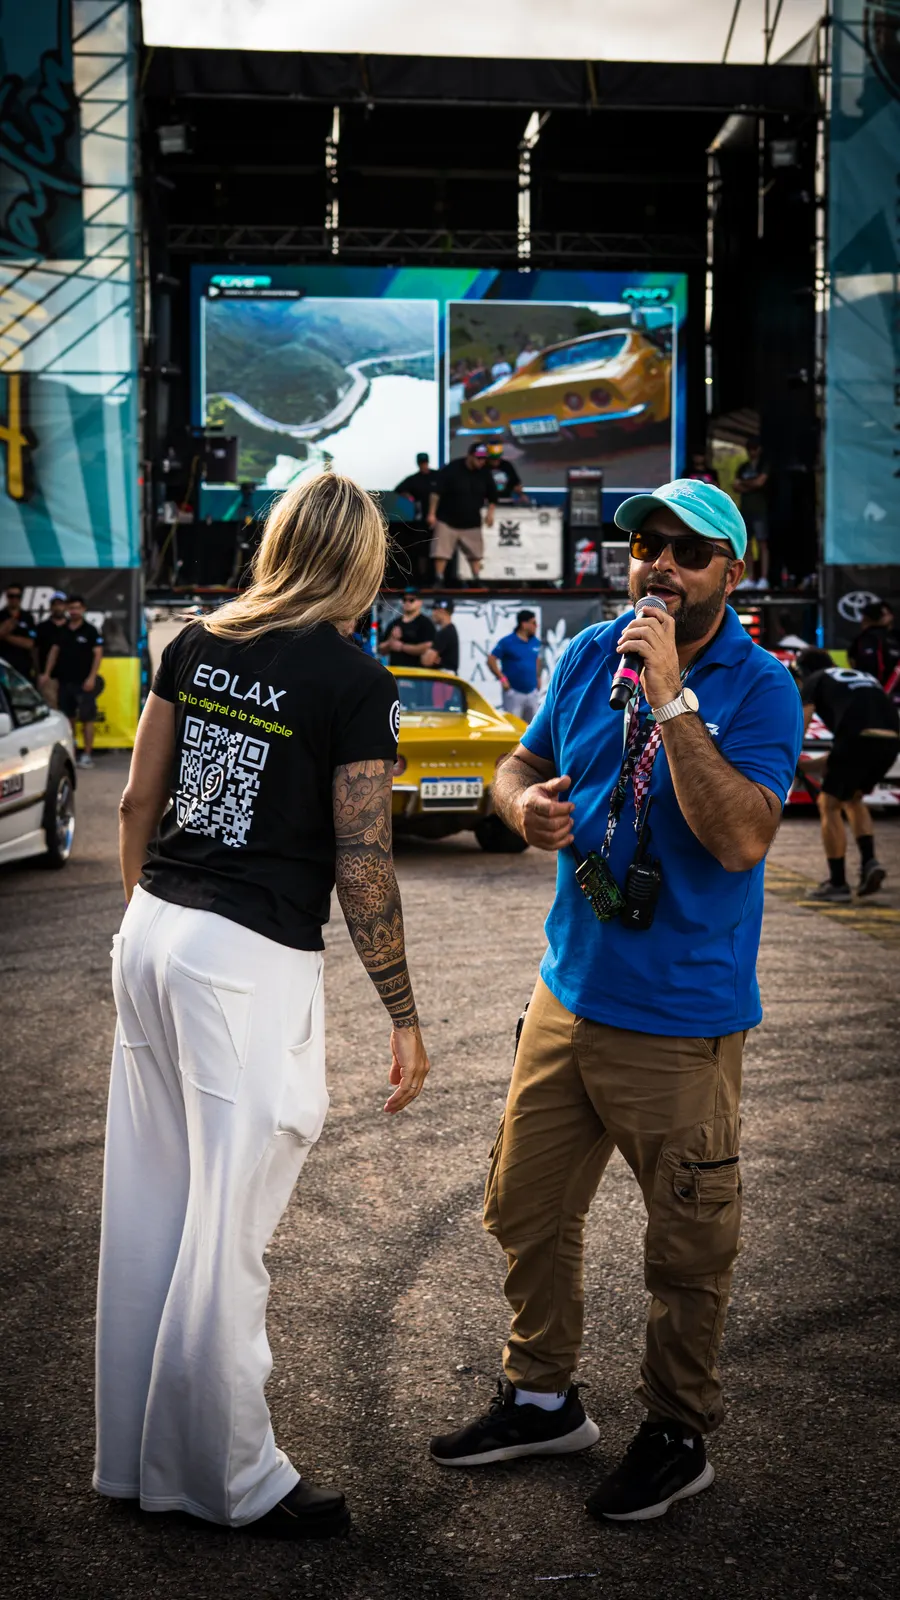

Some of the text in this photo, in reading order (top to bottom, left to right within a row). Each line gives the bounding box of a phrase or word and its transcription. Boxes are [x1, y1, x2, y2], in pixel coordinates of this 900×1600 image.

[193, 664, 287, 712] EOLAX
[188, 693, 198, 705] lo
[199, 698, 230, 713] digital
[230, 709, 237, 718] a
[238, 709, 248, 721] lo
[249, 714, 293, 738] tangible
[632, 909, 640, 920] 2
